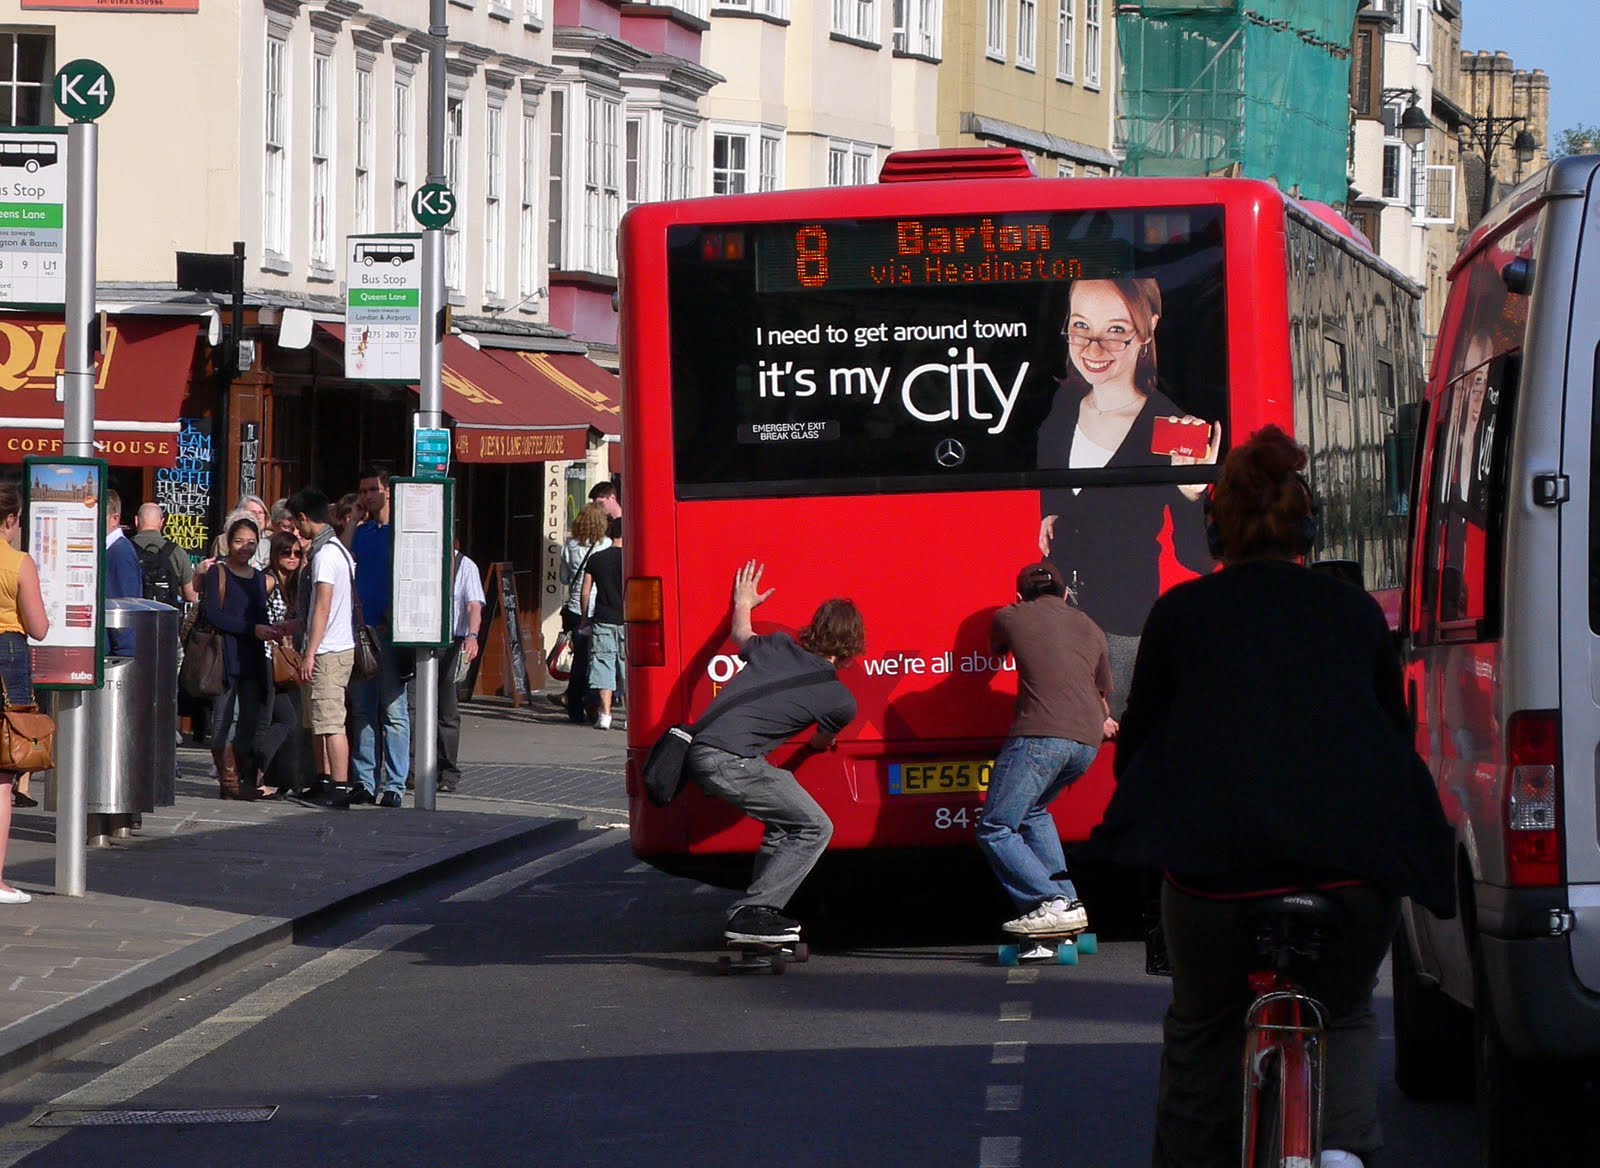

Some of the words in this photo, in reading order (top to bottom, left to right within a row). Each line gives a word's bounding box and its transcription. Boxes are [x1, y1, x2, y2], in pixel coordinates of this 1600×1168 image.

[61, 74, 108, 105] K4
[13, 183, 46, 200] Stop
[417, 191, 453, 215] K5
[22, 209, 46, 219] Lane
[29, 239, 58, 248] Barton
[795, 224, 828, 287] 8
[897, 219, 1051, 255] Barton
[22, 261, 28, 269] 9
[43, 261, 57, 271] U1
[871, 258, 912, 285] via
[924, 254, 1083, 284] Headington
[361, 274, 380, 284] Bus
[383, 274, 407, 286] Stop
[360, 293, 387, 302] Queens
[389, 293, 407, 301] Lane
[757, 327, 762, 345] I
[768, 324, 820, 345] need
[826, 325, 848, 343] to
[854, 323, 888, 347] get
[894, 319, 967, 341] around
[973, 320, 1027, 338] town
[759, 360, 817, 397] it's
[829, 366, 891, 404] my
[901, 346, 1030, 434] city
[752, 422, 805, 433] EMERGENCY
[807, 422, 826, 430] EXIT
[760, 432, 789, 441] BREAK
[790, 431, 819, 440] GLASS
[7, 438, 63, 451] COFF
[98, 440, 170, 454] HOUSE
[546, 465, 559, 594] CAPPUCCINO
[864, 653, 926, 676] we're
[931, 651, 954, 673] all
[960, 651, 1017, 673] abou
[905, 765, 970, 789] EF55
